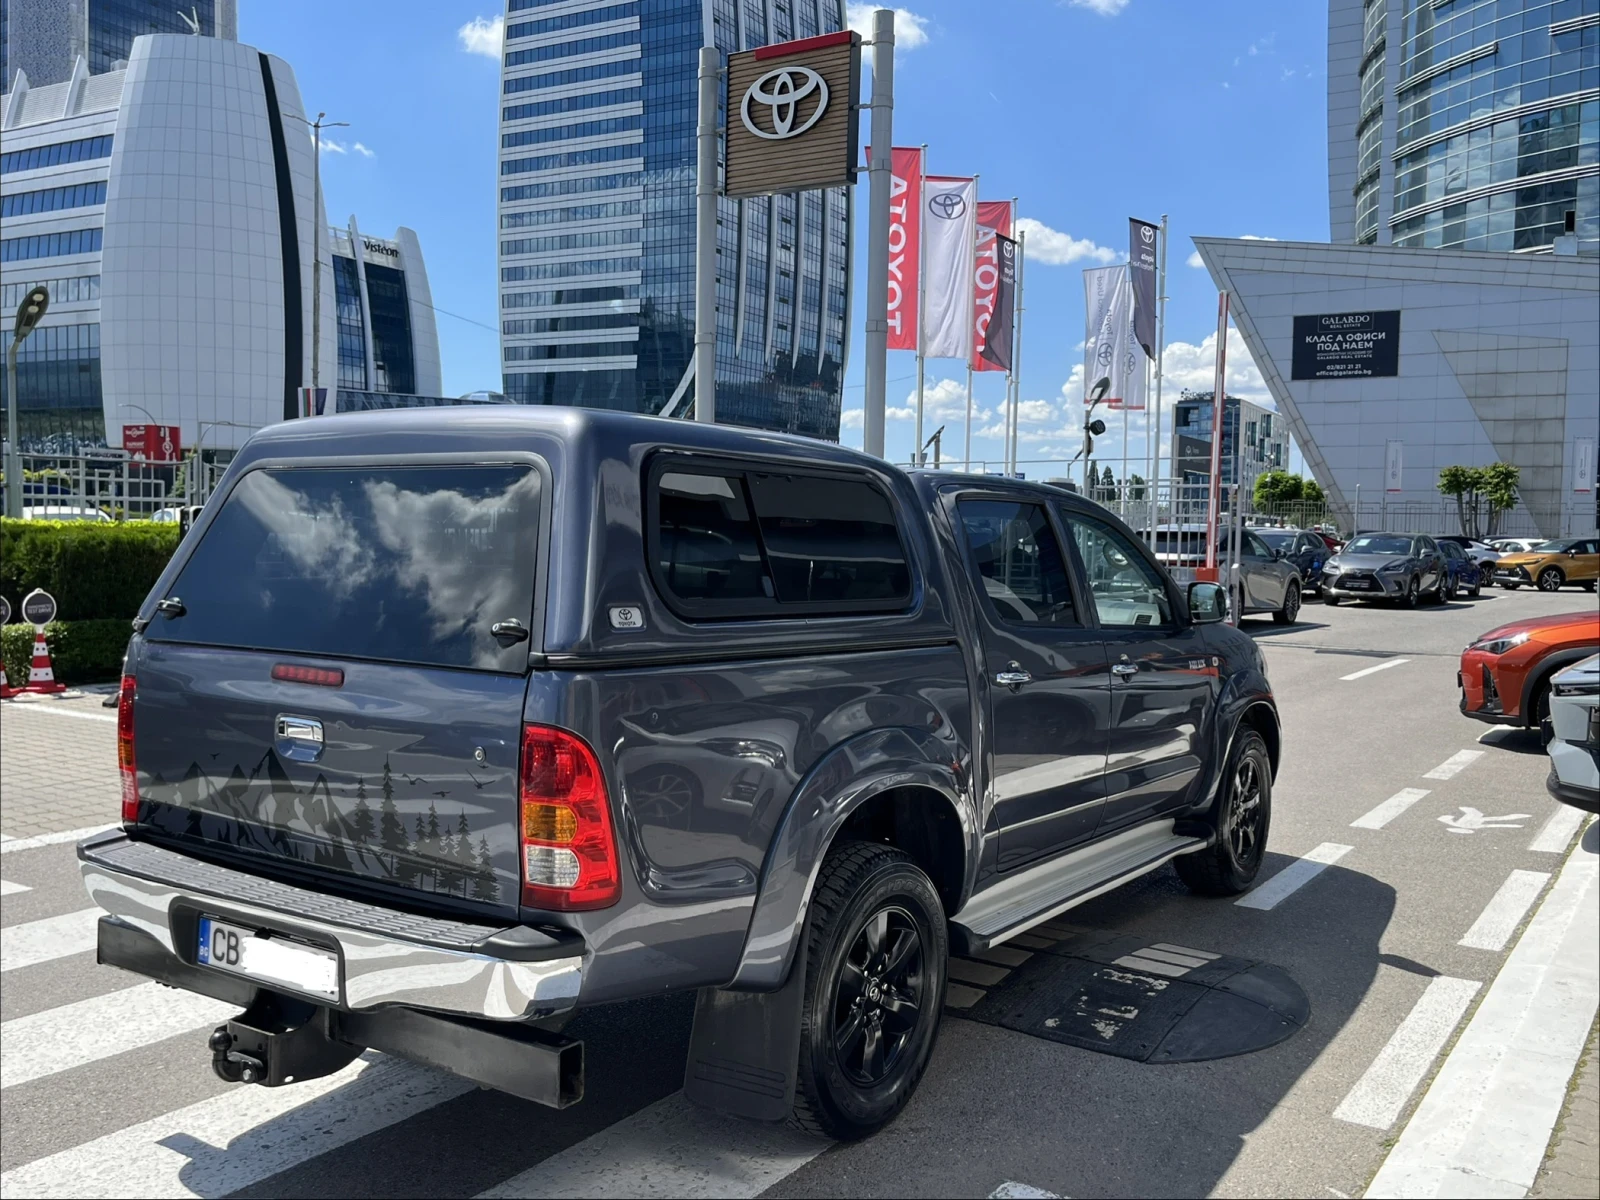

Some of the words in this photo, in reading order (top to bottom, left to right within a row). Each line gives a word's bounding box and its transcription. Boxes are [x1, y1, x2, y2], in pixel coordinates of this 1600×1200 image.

[363, 240, 399, 258] Visteon
[1322, 315, 1370, 324] GALARDO
[1305, 334, 1333, 343] КЛАС
[1346, 332, 1386, 341] ОФИСИ
[1317, 343, 1340, 351] ПОД
[1342, 341, 1373, 350] НАЕМ
[212, 927, 240, 966] CB
